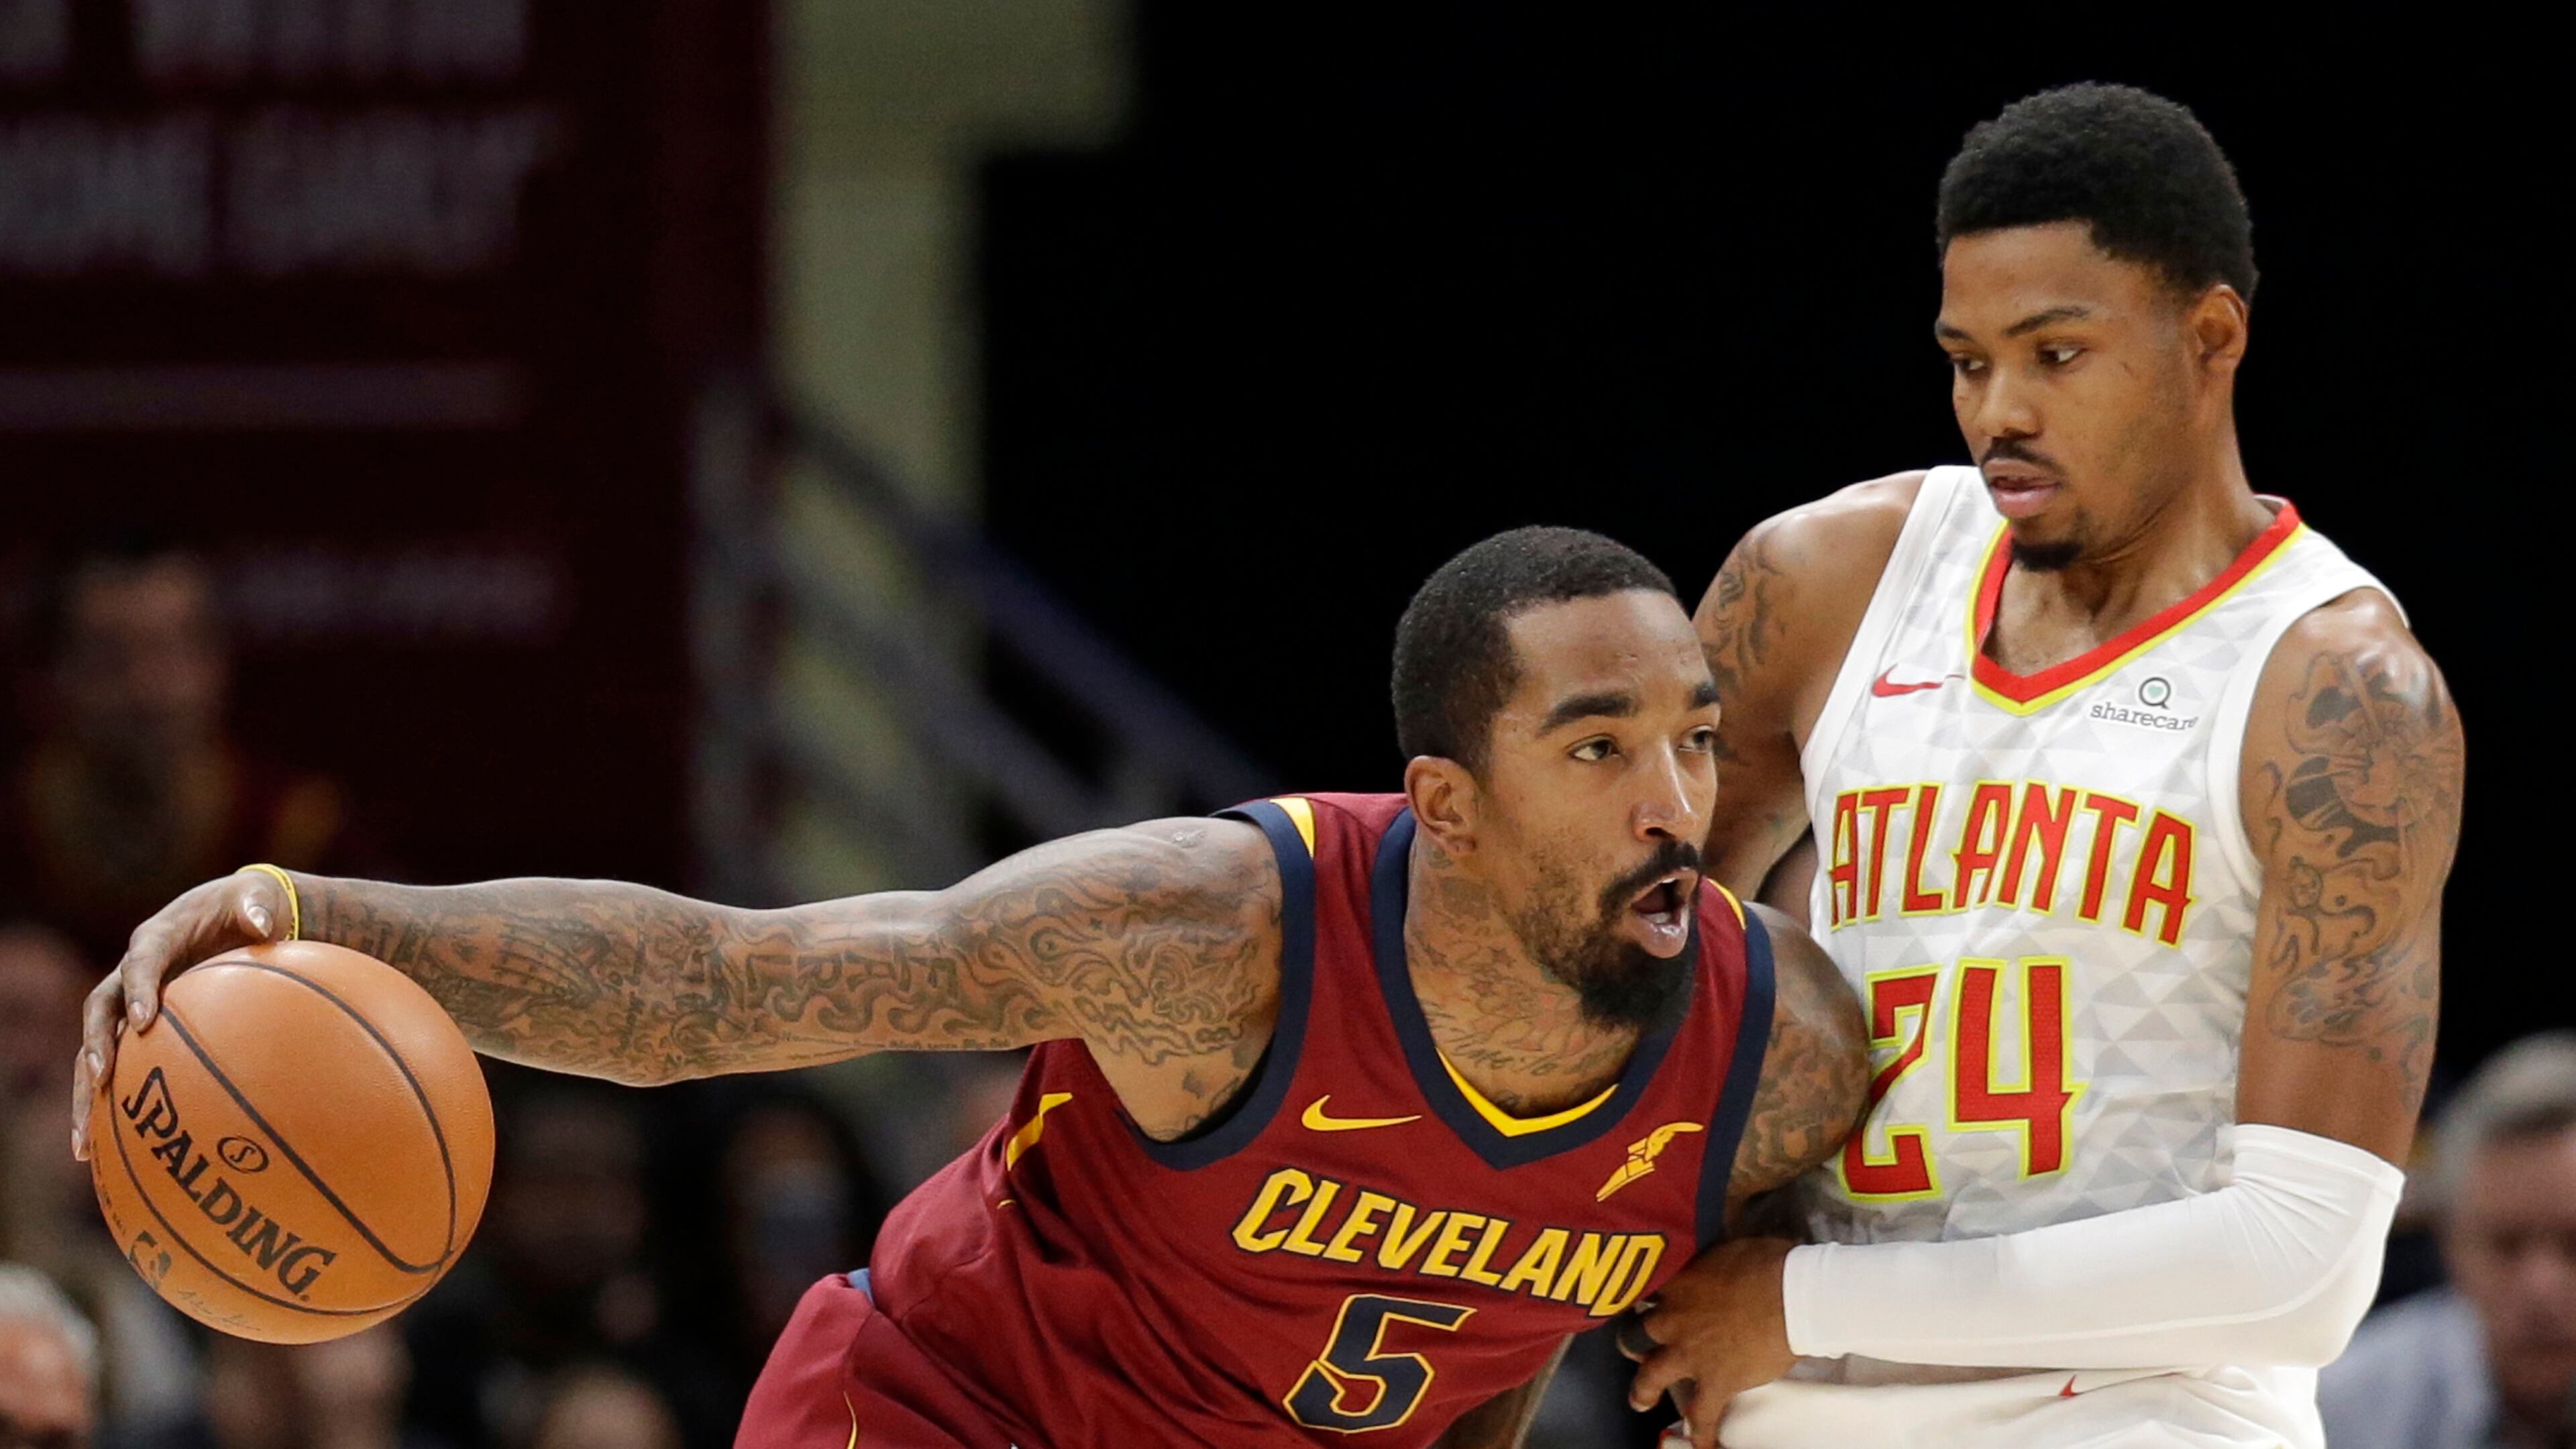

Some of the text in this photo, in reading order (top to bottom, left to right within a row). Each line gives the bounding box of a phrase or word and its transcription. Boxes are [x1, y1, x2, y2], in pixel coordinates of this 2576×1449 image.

[1827, 779, 2198, 949] ATLANTA
[1838, 955, 2088, 1202] 24
[122, 1067, 337, 1295] SPALDING
[1231, 1167, 1666, 1317] CLEVELAND
[1283, 1293, 1477, 1434] 5
